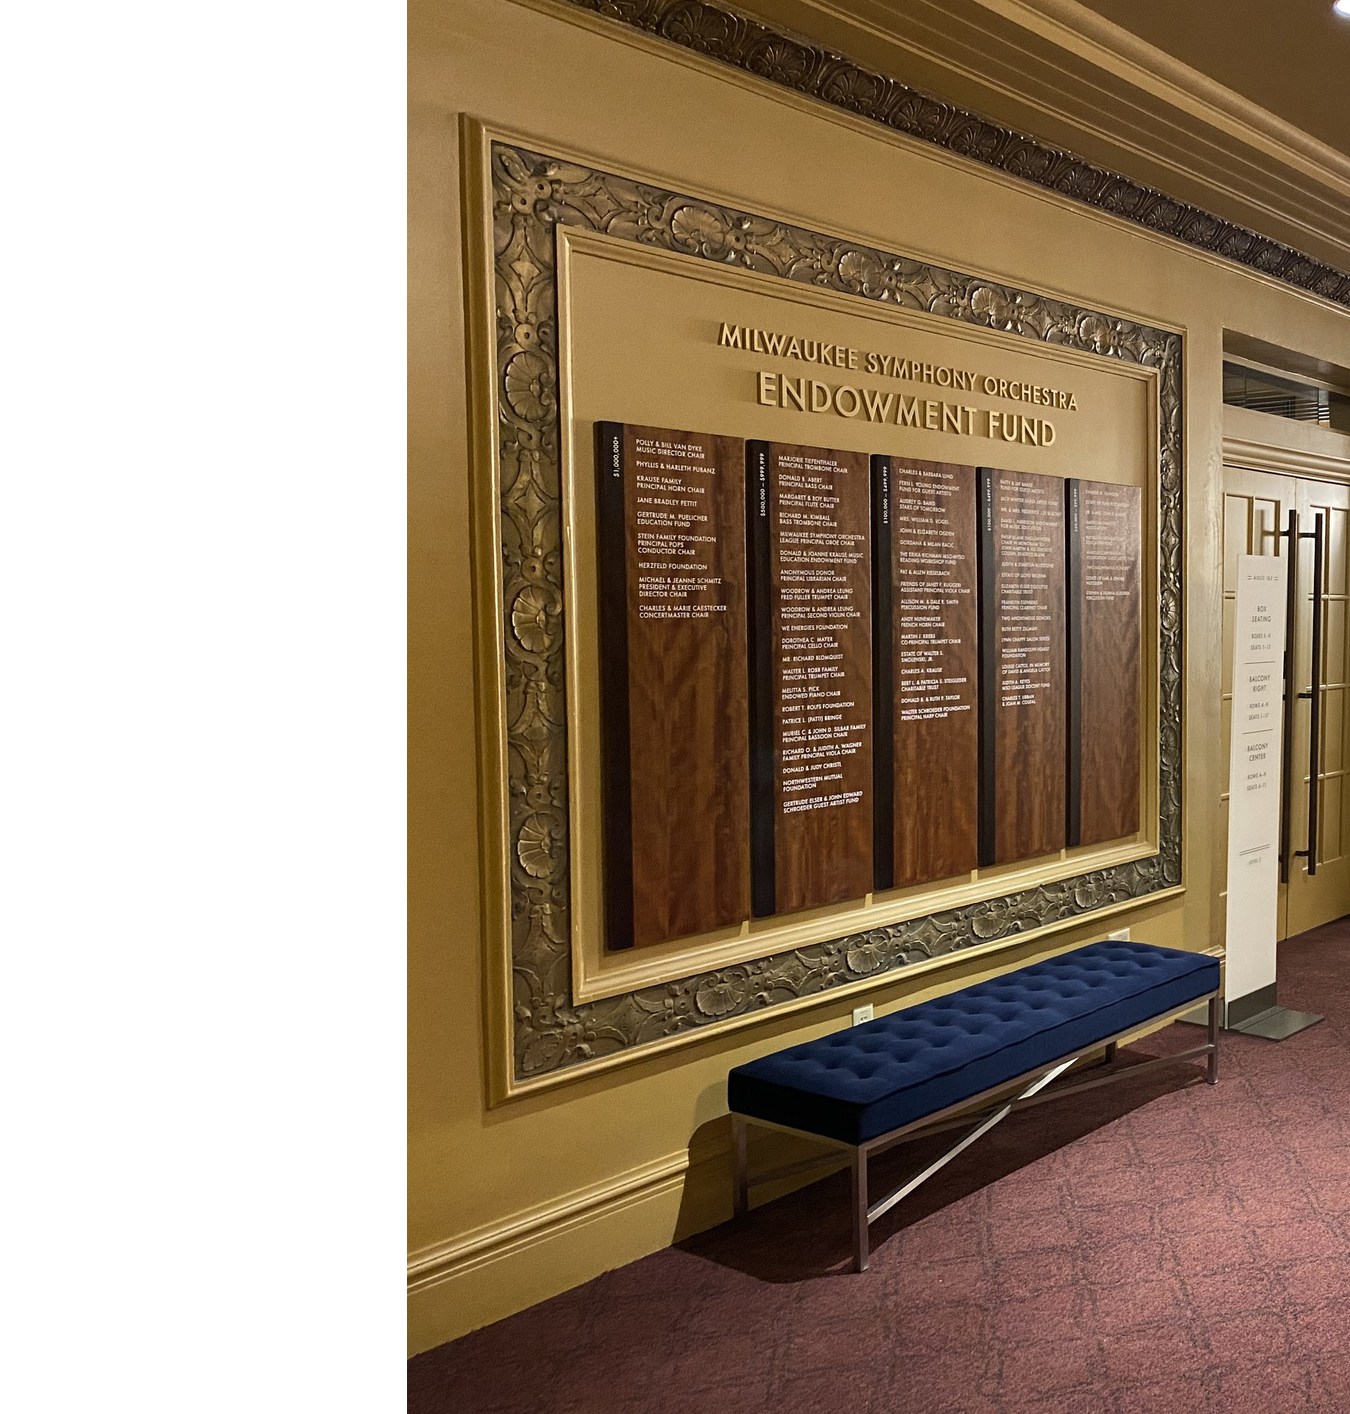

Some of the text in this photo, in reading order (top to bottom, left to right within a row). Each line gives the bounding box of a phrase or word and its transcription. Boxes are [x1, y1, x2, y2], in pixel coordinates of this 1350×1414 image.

[718, 322, 1078, 412] MILWAUKEE SYMPHONY ORCHESTRA
[757, 372, 1056, 447] ENDOWMENT FUND
[636, 439, 654, 447] POLLY
[688, 444, 702, 452] DYKE
[636, 446, 705, 459] MUSIC DIRECTOR CHAIR
[636, 461, 658, 469] PHYLLIS
[779, 461, 804, 469] PRINCIPAL
[805, 464, 832, 472] TROMBONE
[661, 477, 682, 485] FAMILY
[637, 482, 666, 490] PRINCIPAL
[687, 486, 705, 494] CHAIR
[654, 498, 679, 506] BRADLEY
[637, 511, 667, 519] GERTRUDE
[822, 701, 855, 709] FOUNDATION
[783, 773, 843, 786] NORTHWESTERN MUTUAL
[783, 783, 816, 792] FOUNDATION
